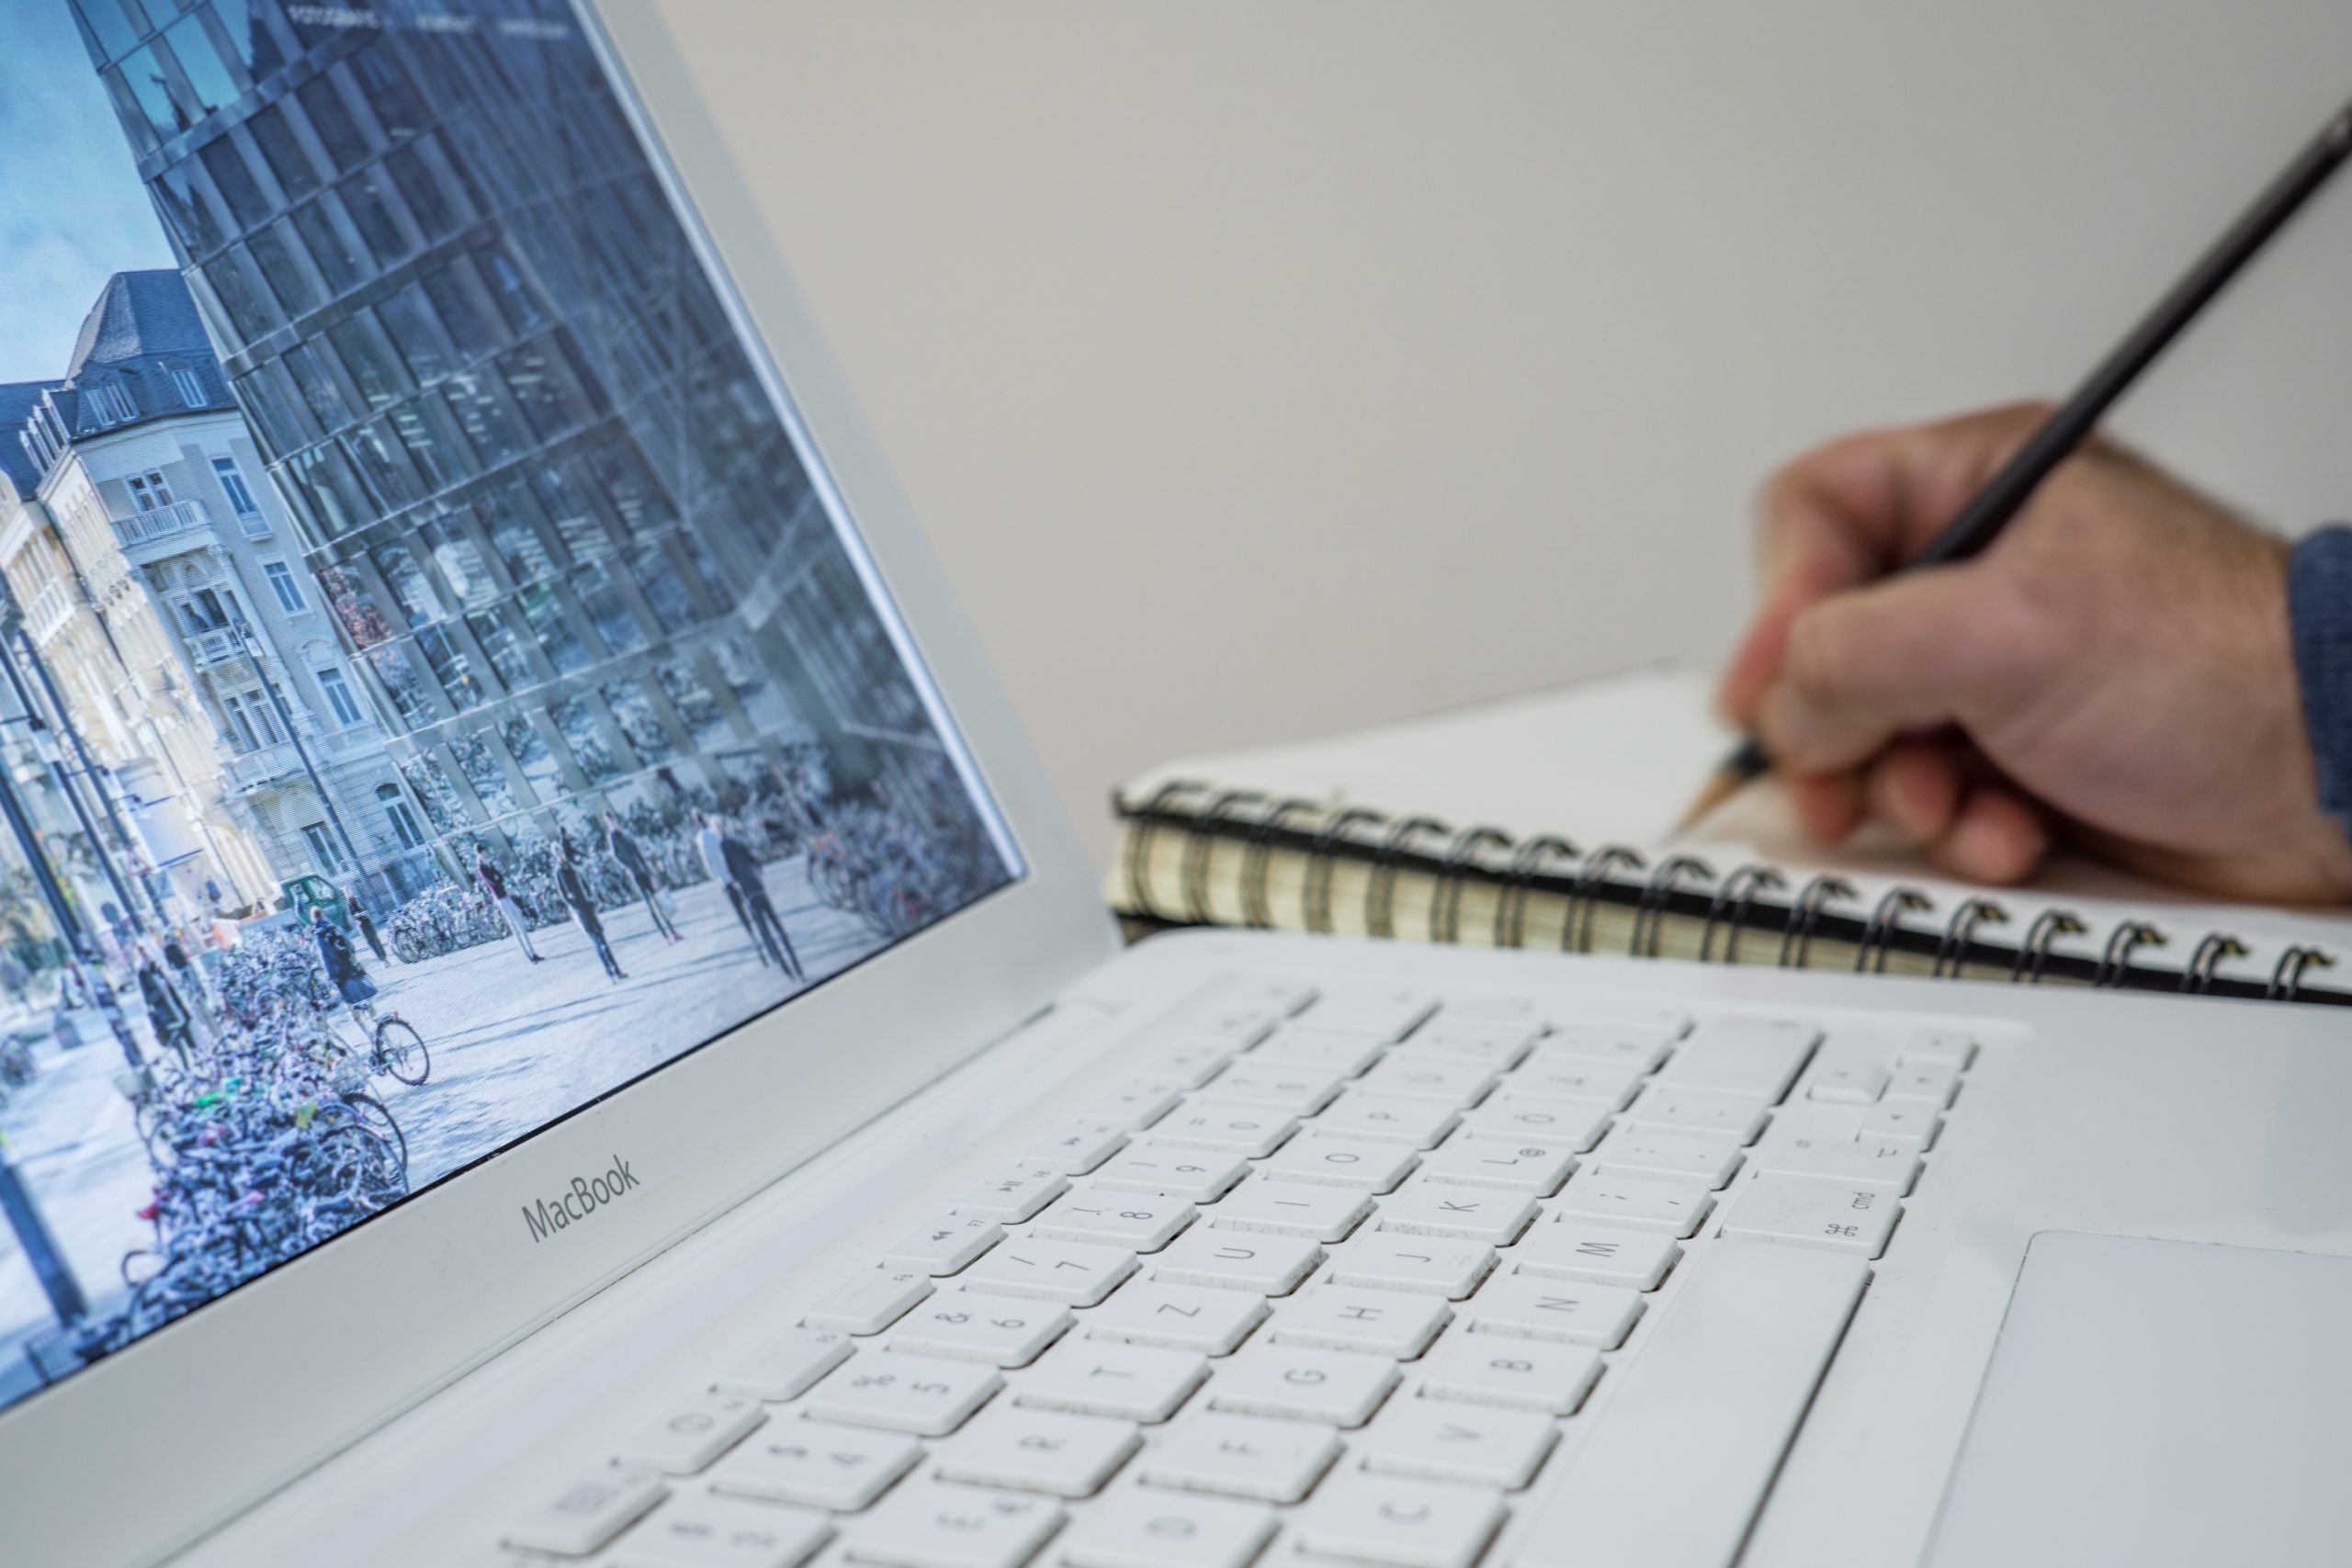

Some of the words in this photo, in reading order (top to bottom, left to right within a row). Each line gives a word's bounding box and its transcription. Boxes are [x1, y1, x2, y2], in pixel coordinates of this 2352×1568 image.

[1519, 1147, 1547, 1157] @
[1175, 1165, 1207, 1173] 9
[522, 1154, 640, 1244] MacBook
[1851, 1190, 1875, 1210] cmd
[1438, 1200, 1480, 1213] K
[1120, 1210, 1153, 1220] 8
[967, 1219, 986, 1228] F7
[1214, 1247, 1256, 1260] U
[1576, 1241, 1621, 1258] M
[1396, 1252, 1431, 1263] J
[1056, 1260, 1091, 1271] 7
[1157, 1303, 1202, 1317] Z
[1534, 1296, 1580, 1312] N
[934, 1312, 975, 1325] &
[1338, 1305, 1385, 1321] H
[990, 1317, 1025, 1329] 6
[1489, 1359, 1534, 1372] B
[1284, 1368, 1327, 1385] G
